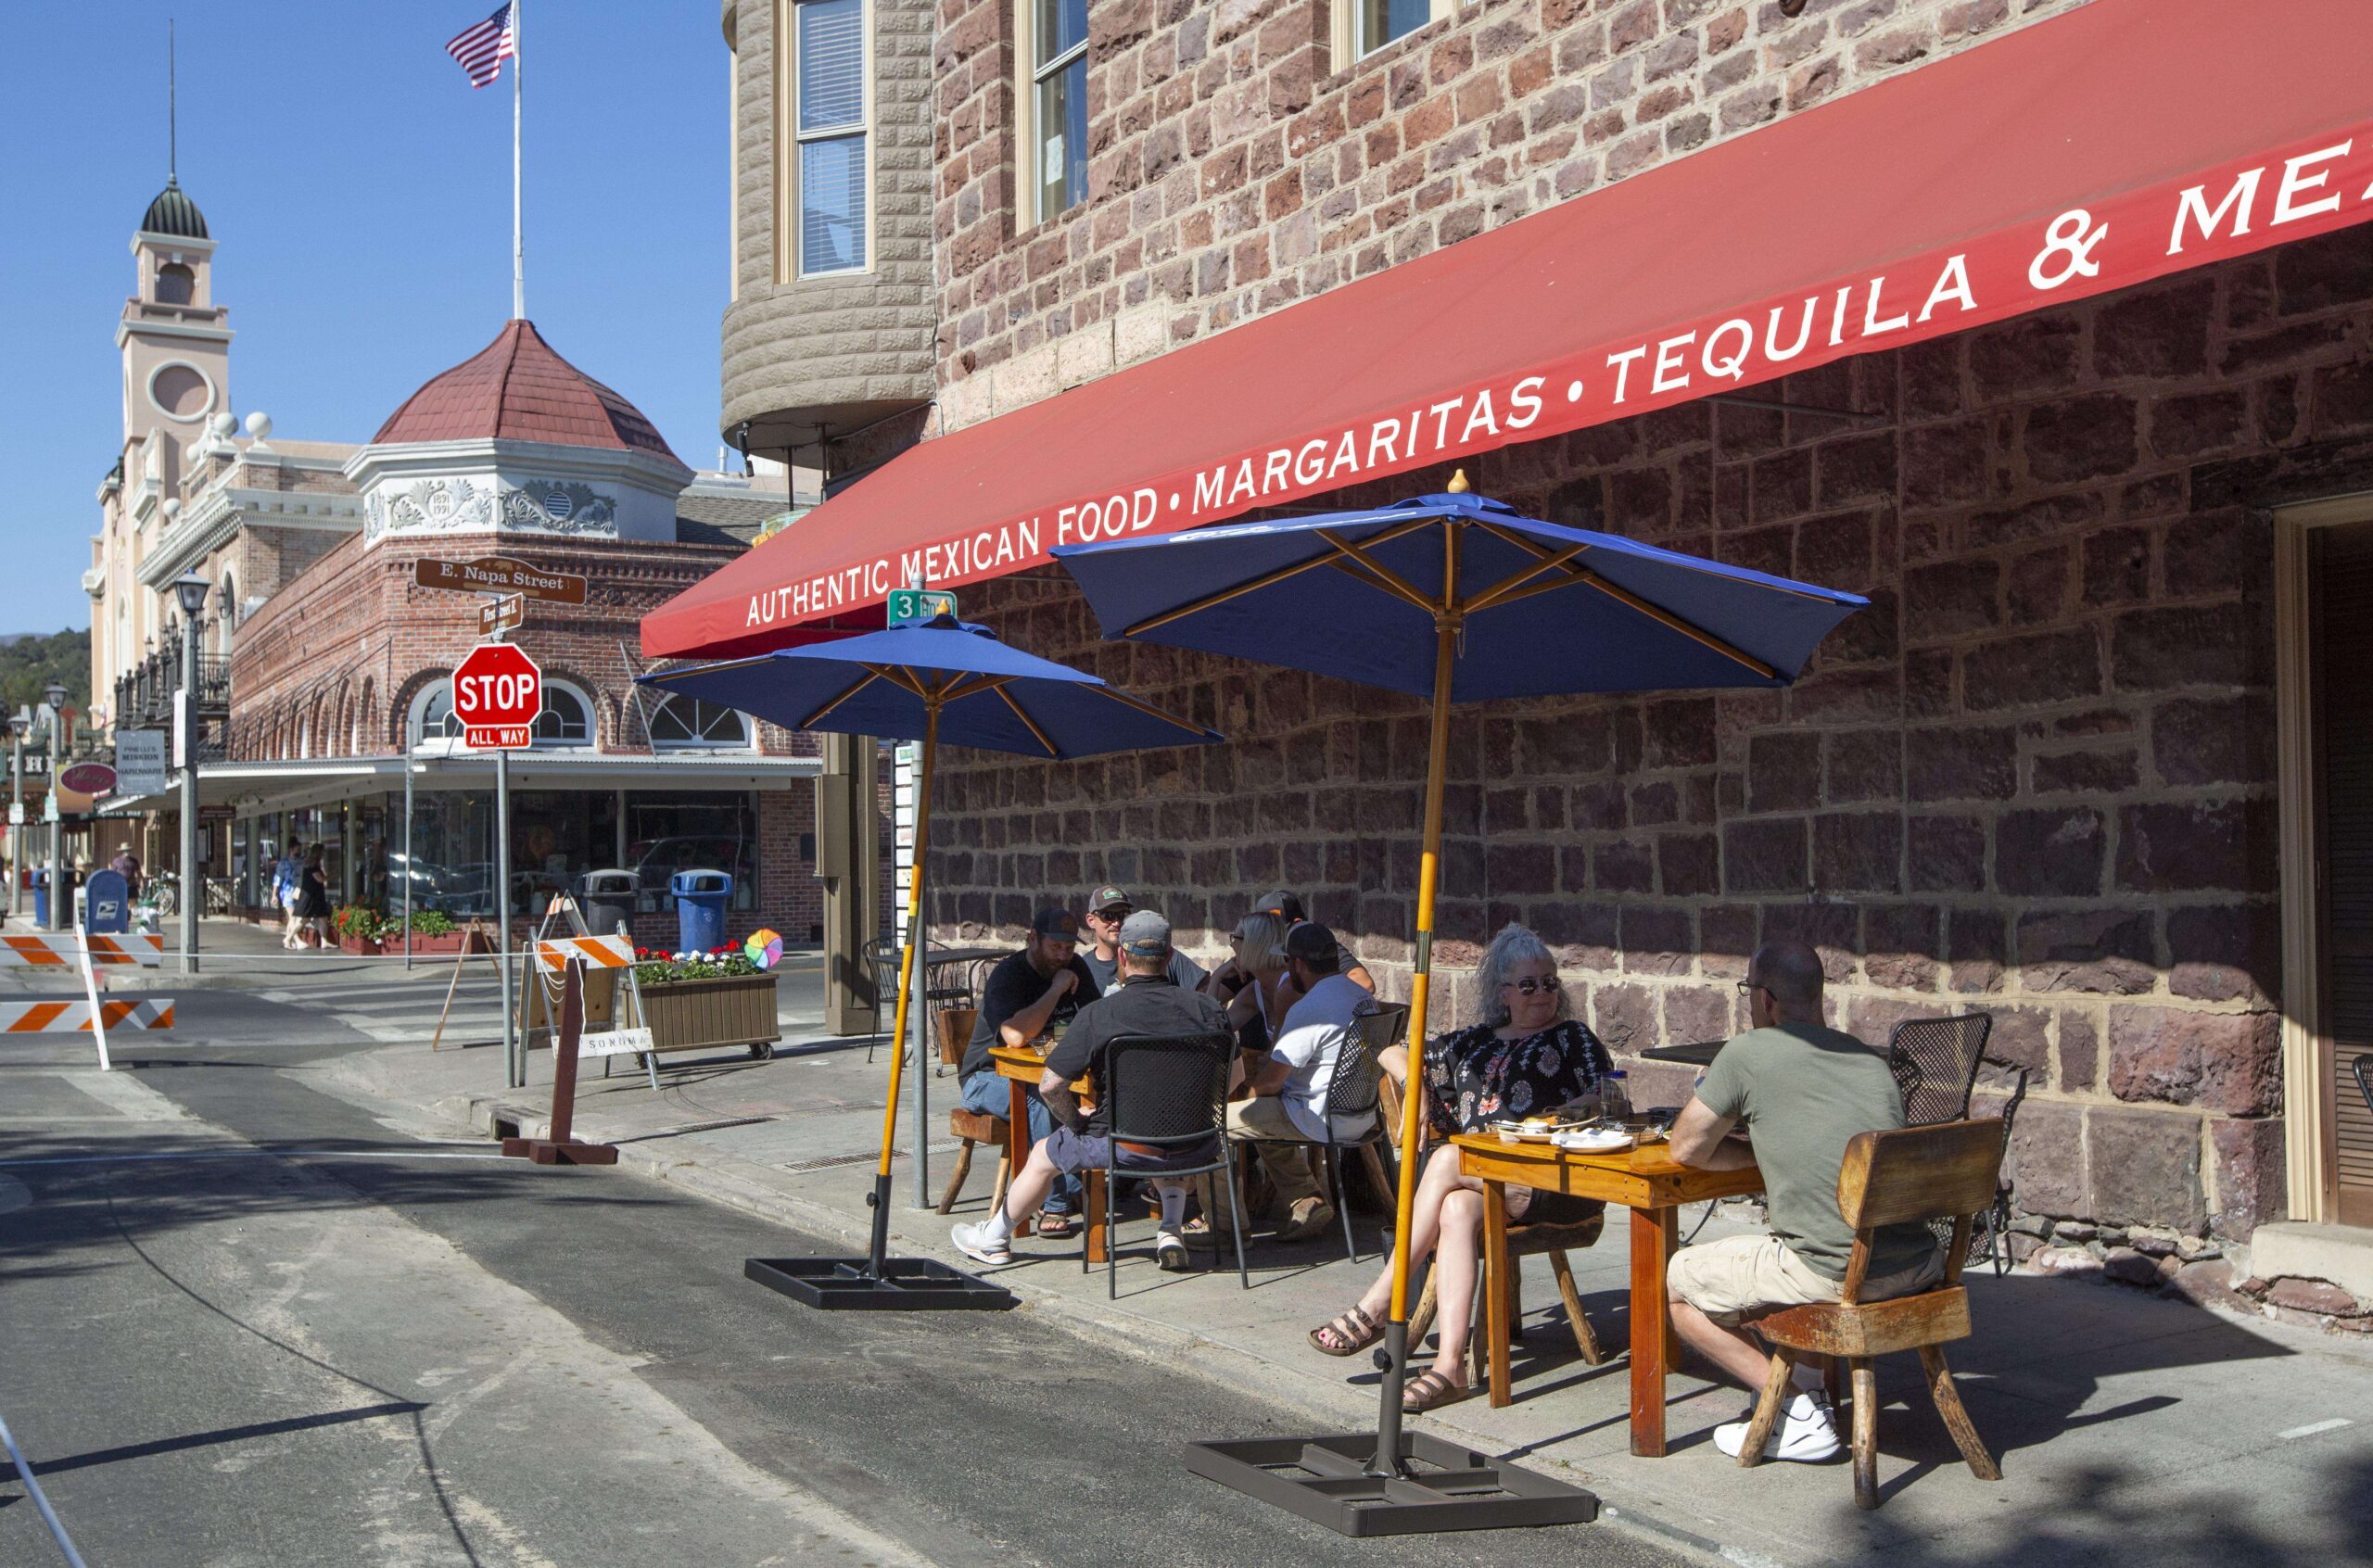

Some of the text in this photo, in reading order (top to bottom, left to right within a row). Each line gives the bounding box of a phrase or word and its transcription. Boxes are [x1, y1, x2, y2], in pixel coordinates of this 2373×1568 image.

[746, 138, 2373, 627] AUTHENTIC MEXICAN FOOD MARGARITAS TEQUILA & ME
[433, 494, 450, 504] 1891
[433, 505, 450, 514] 1991
[439, 563, 458, 578] E.
[463, 565, 509, 585] Napa
[513, 572, 564, 590] Street
[897, 595, 913, 618] 3
[460, 674, 535, 712] STOP
[470, 729, 526, 745] ALL WAY
